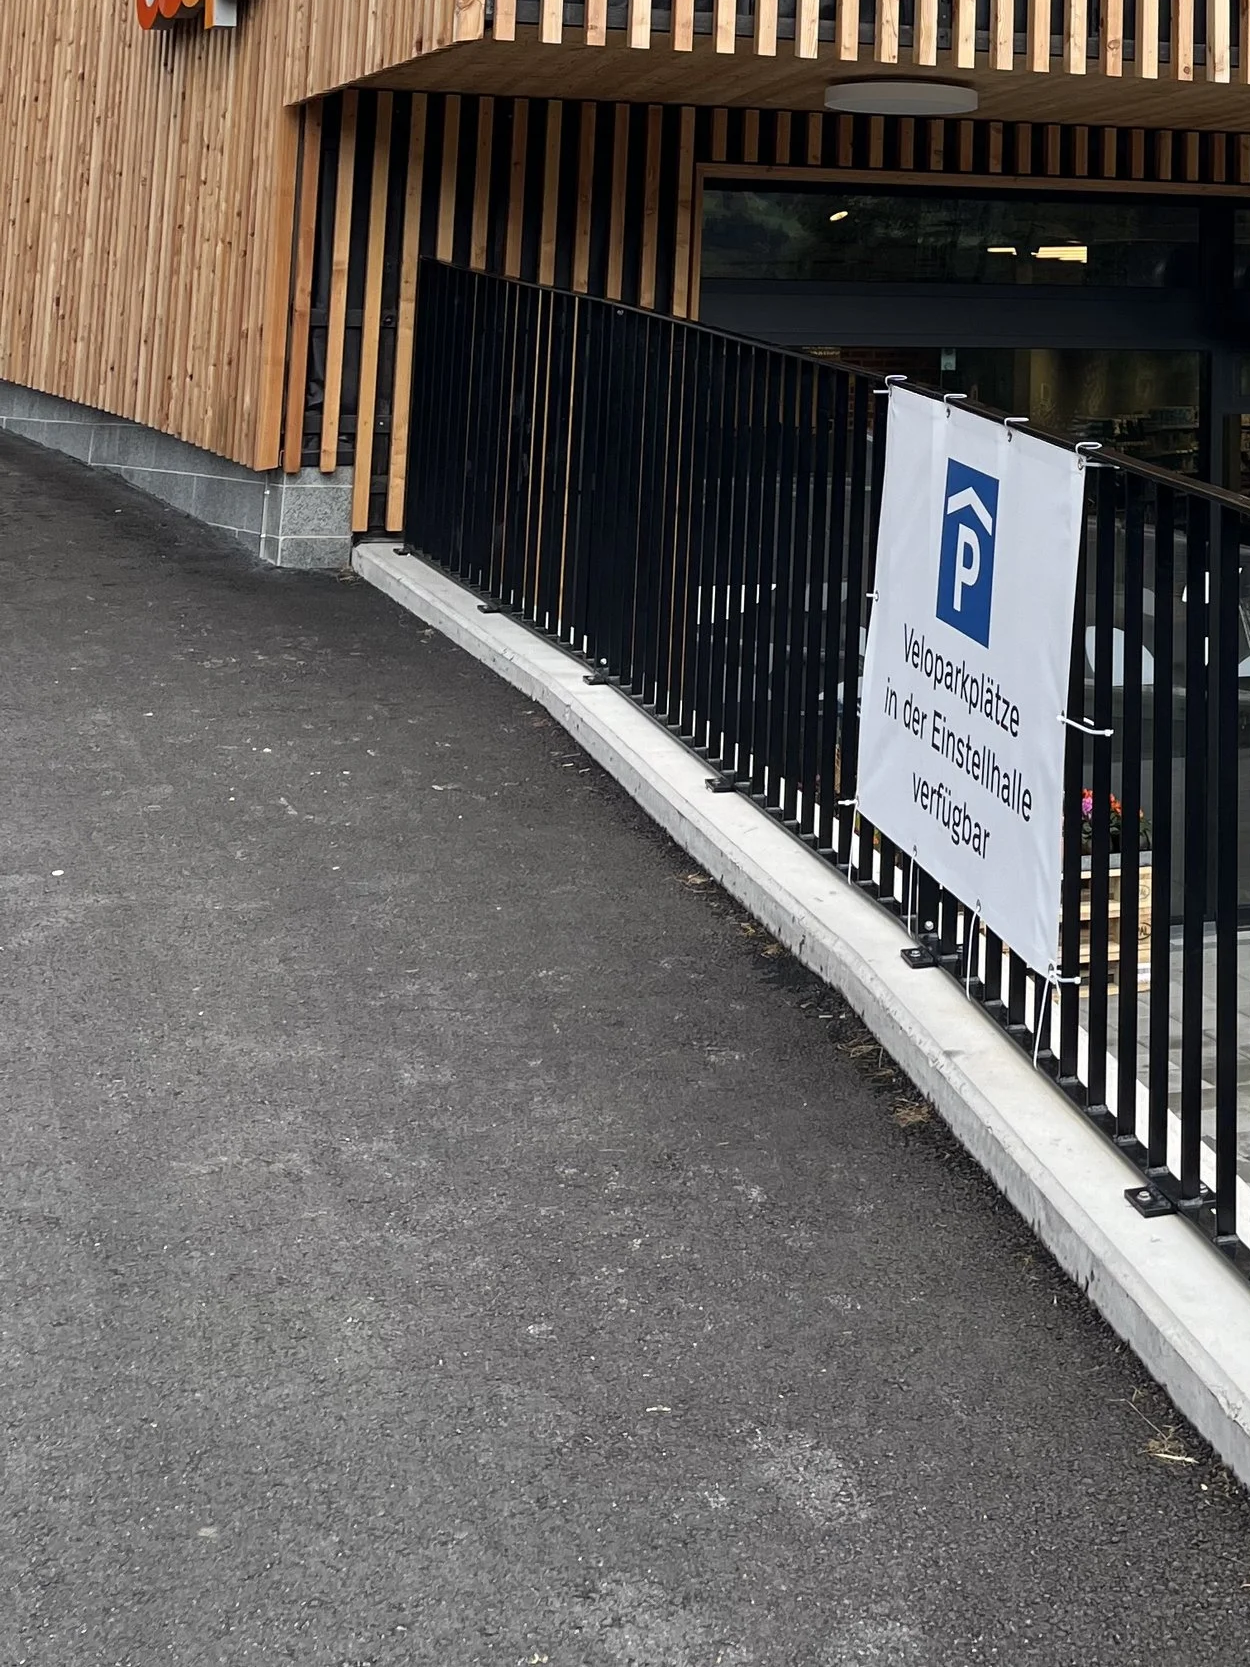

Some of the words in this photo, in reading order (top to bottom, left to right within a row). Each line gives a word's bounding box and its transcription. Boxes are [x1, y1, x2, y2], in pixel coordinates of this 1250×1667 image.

[952, 521, 980, 612] P
[904, 623, 1020, 738] Veloparkplätze
[884, 677, 897, 720] in
[903, 693, 927, 739] der
[931, 709, 1032, 822] Einstellhalle
[912, 772, 990, 859] verfügbar
